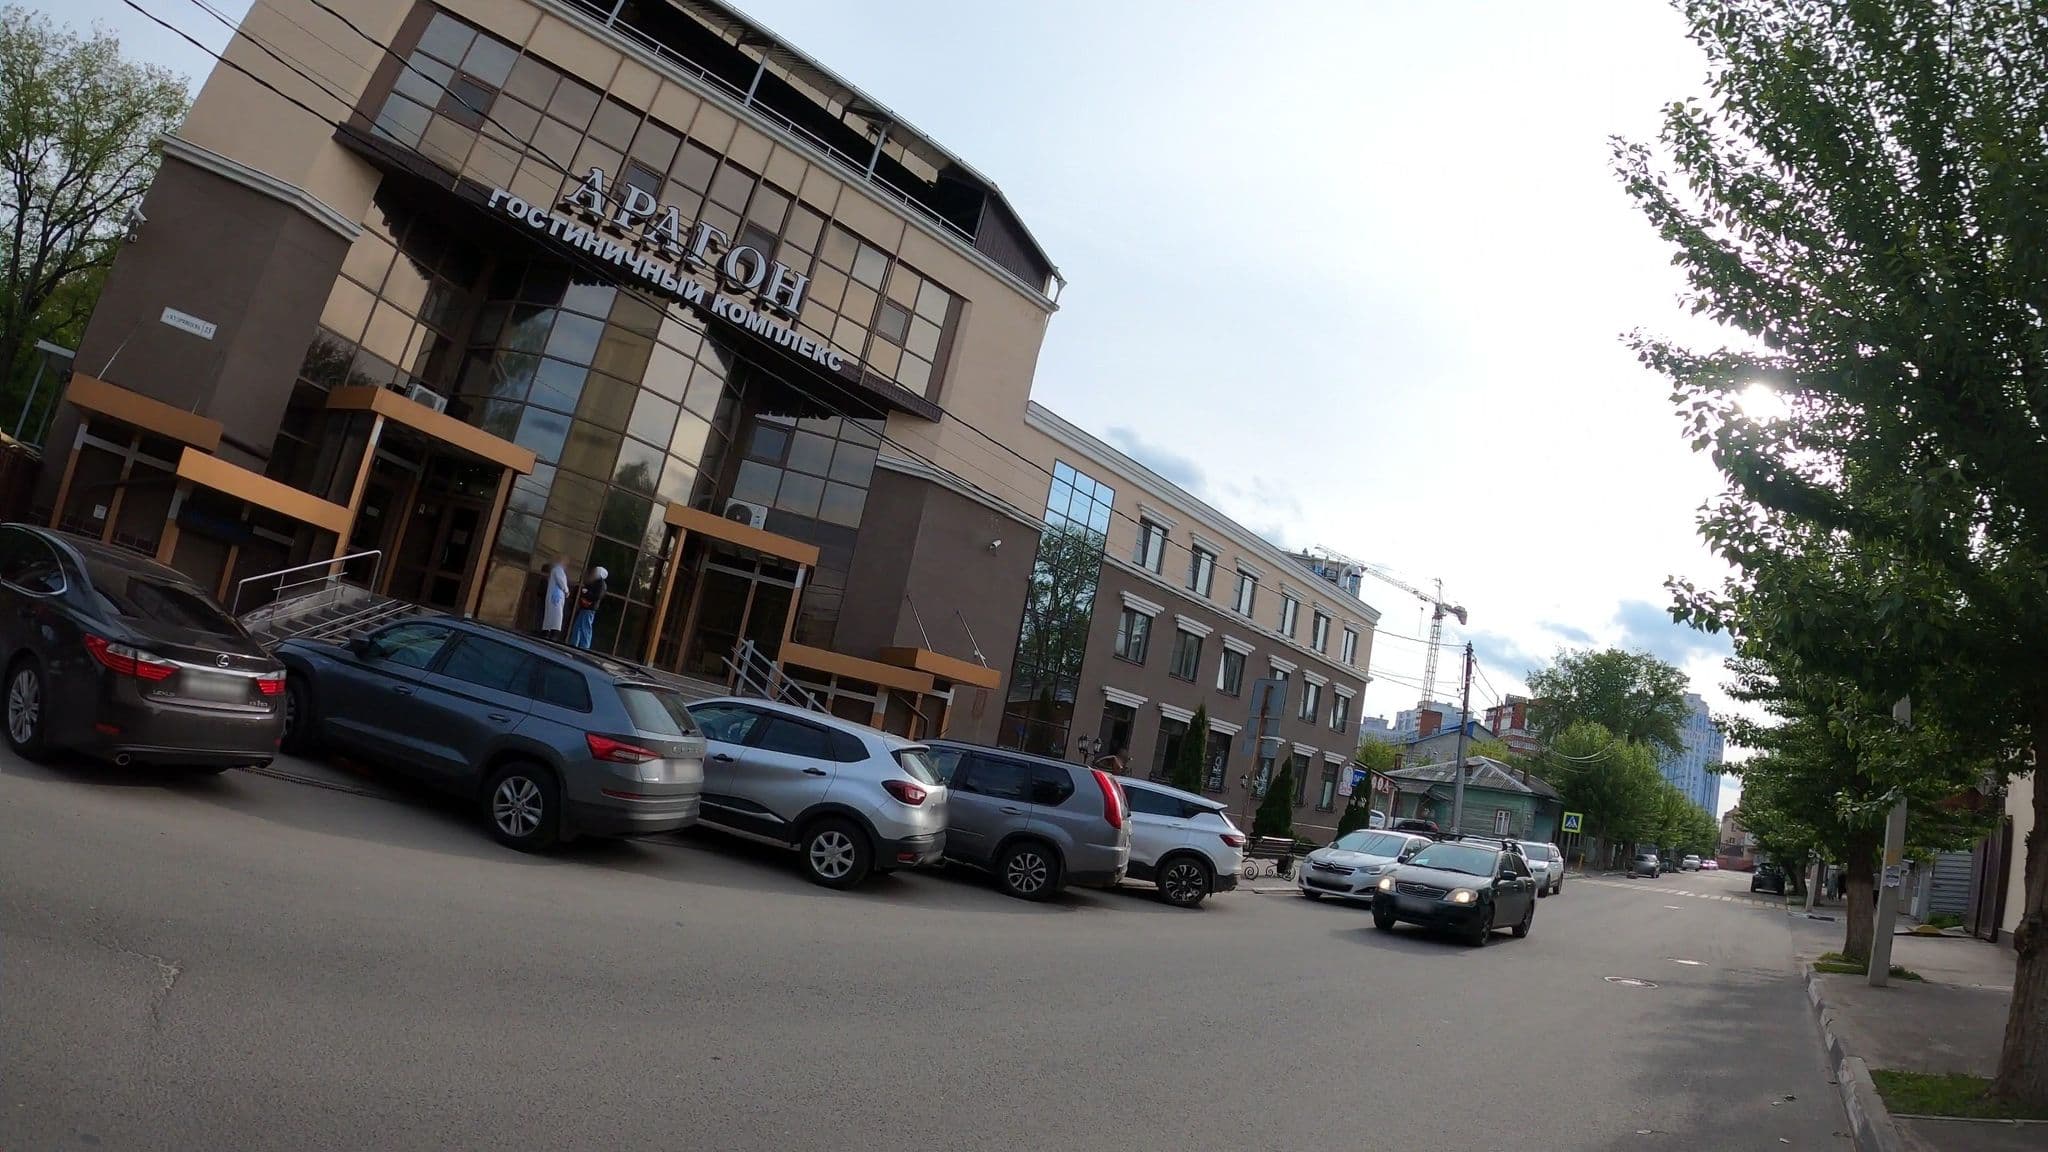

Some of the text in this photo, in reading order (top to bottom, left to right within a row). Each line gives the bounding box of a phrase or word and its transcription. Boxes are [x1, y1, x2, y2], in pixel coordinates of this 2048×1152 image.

[488, 188, 844, 371] ГОСТИНИЧНЫЙ КОМПЛЕКС
[564, 168, 810, 314] АРАГОН
